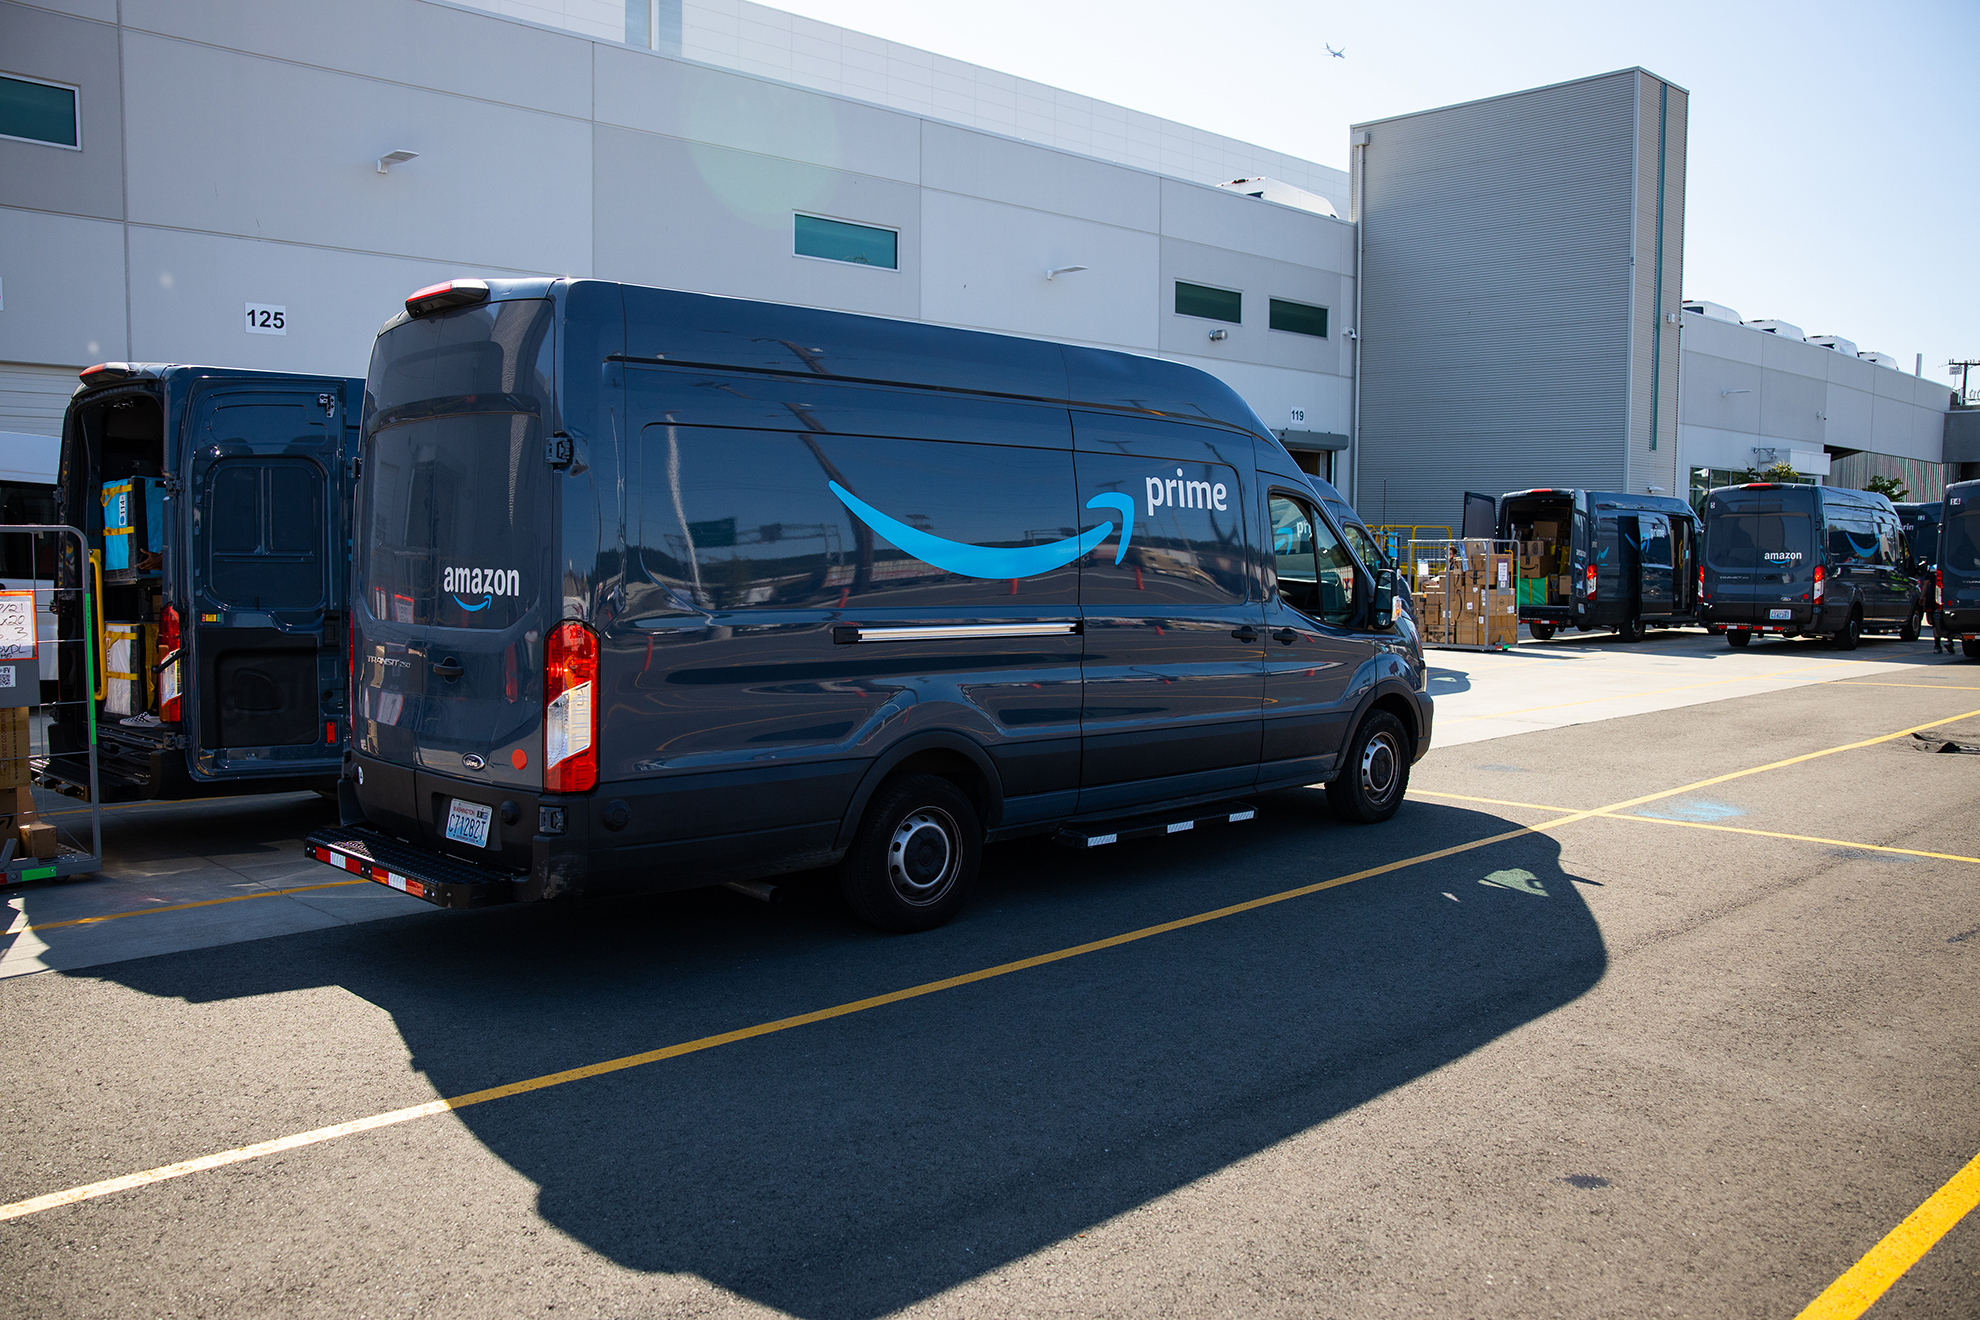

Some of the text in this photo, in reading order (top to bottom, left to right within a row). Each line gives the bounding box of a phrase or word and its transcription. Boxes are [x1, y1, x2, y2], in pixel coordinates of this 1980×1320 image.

[246, 308, 286, 330] 125
[1291, 409, 1305, 422] 119
[1145, 467, 1228, 517] prime
[1764, 551, 1803, 560] amazon
[443, 566, 520, 597] amazon
[366, 654, 400, 667] TRANSIT
[448, 813, 487, 841] C71282T
